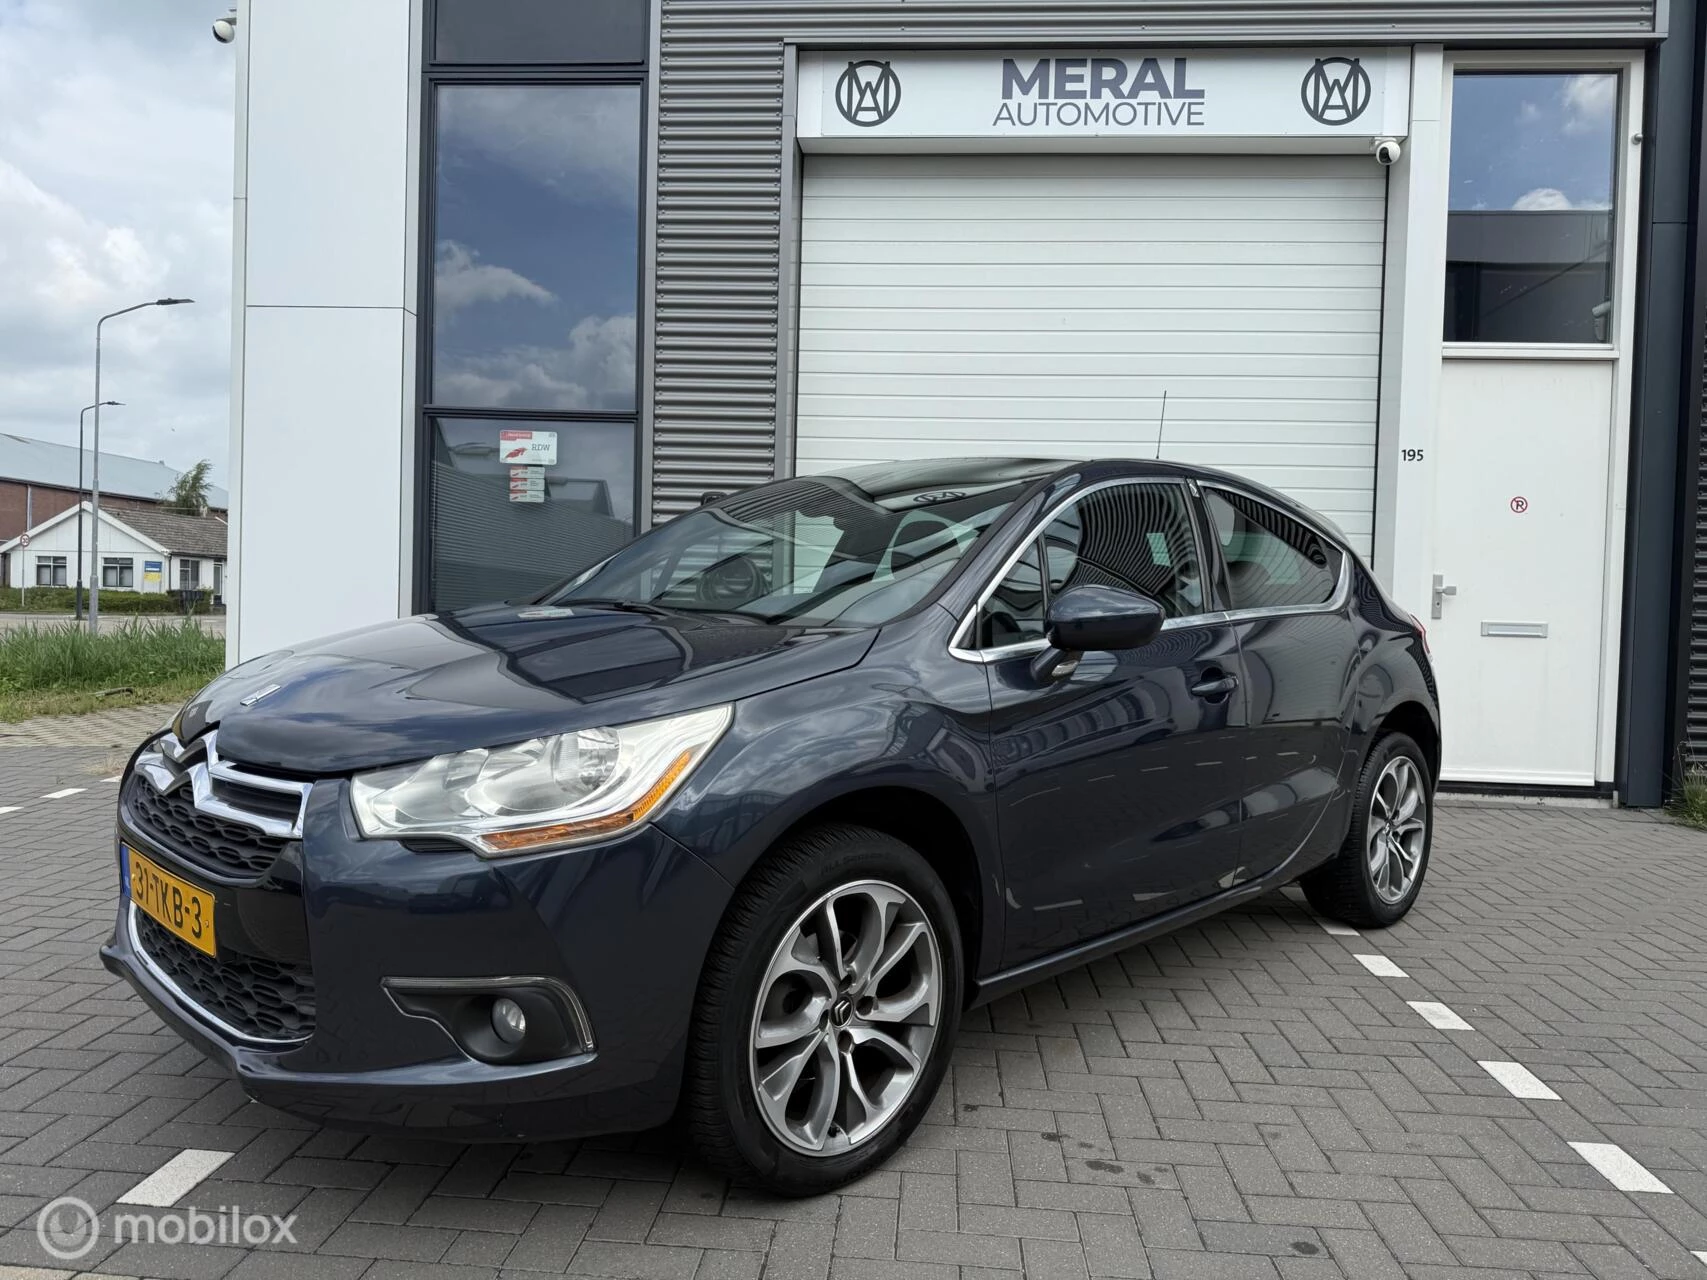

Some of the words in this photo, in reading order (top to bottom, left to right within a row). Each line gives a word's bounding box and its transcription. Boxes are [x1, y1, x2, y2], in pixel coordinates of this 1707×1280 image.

[1001, 57, 1205, 100] MERAL
[992, 101, 1205, 127] AUTOMOTIVE
[1401, 448, 1424, 462] 195
[135, 861, 202, 939] 31-TKB-3
